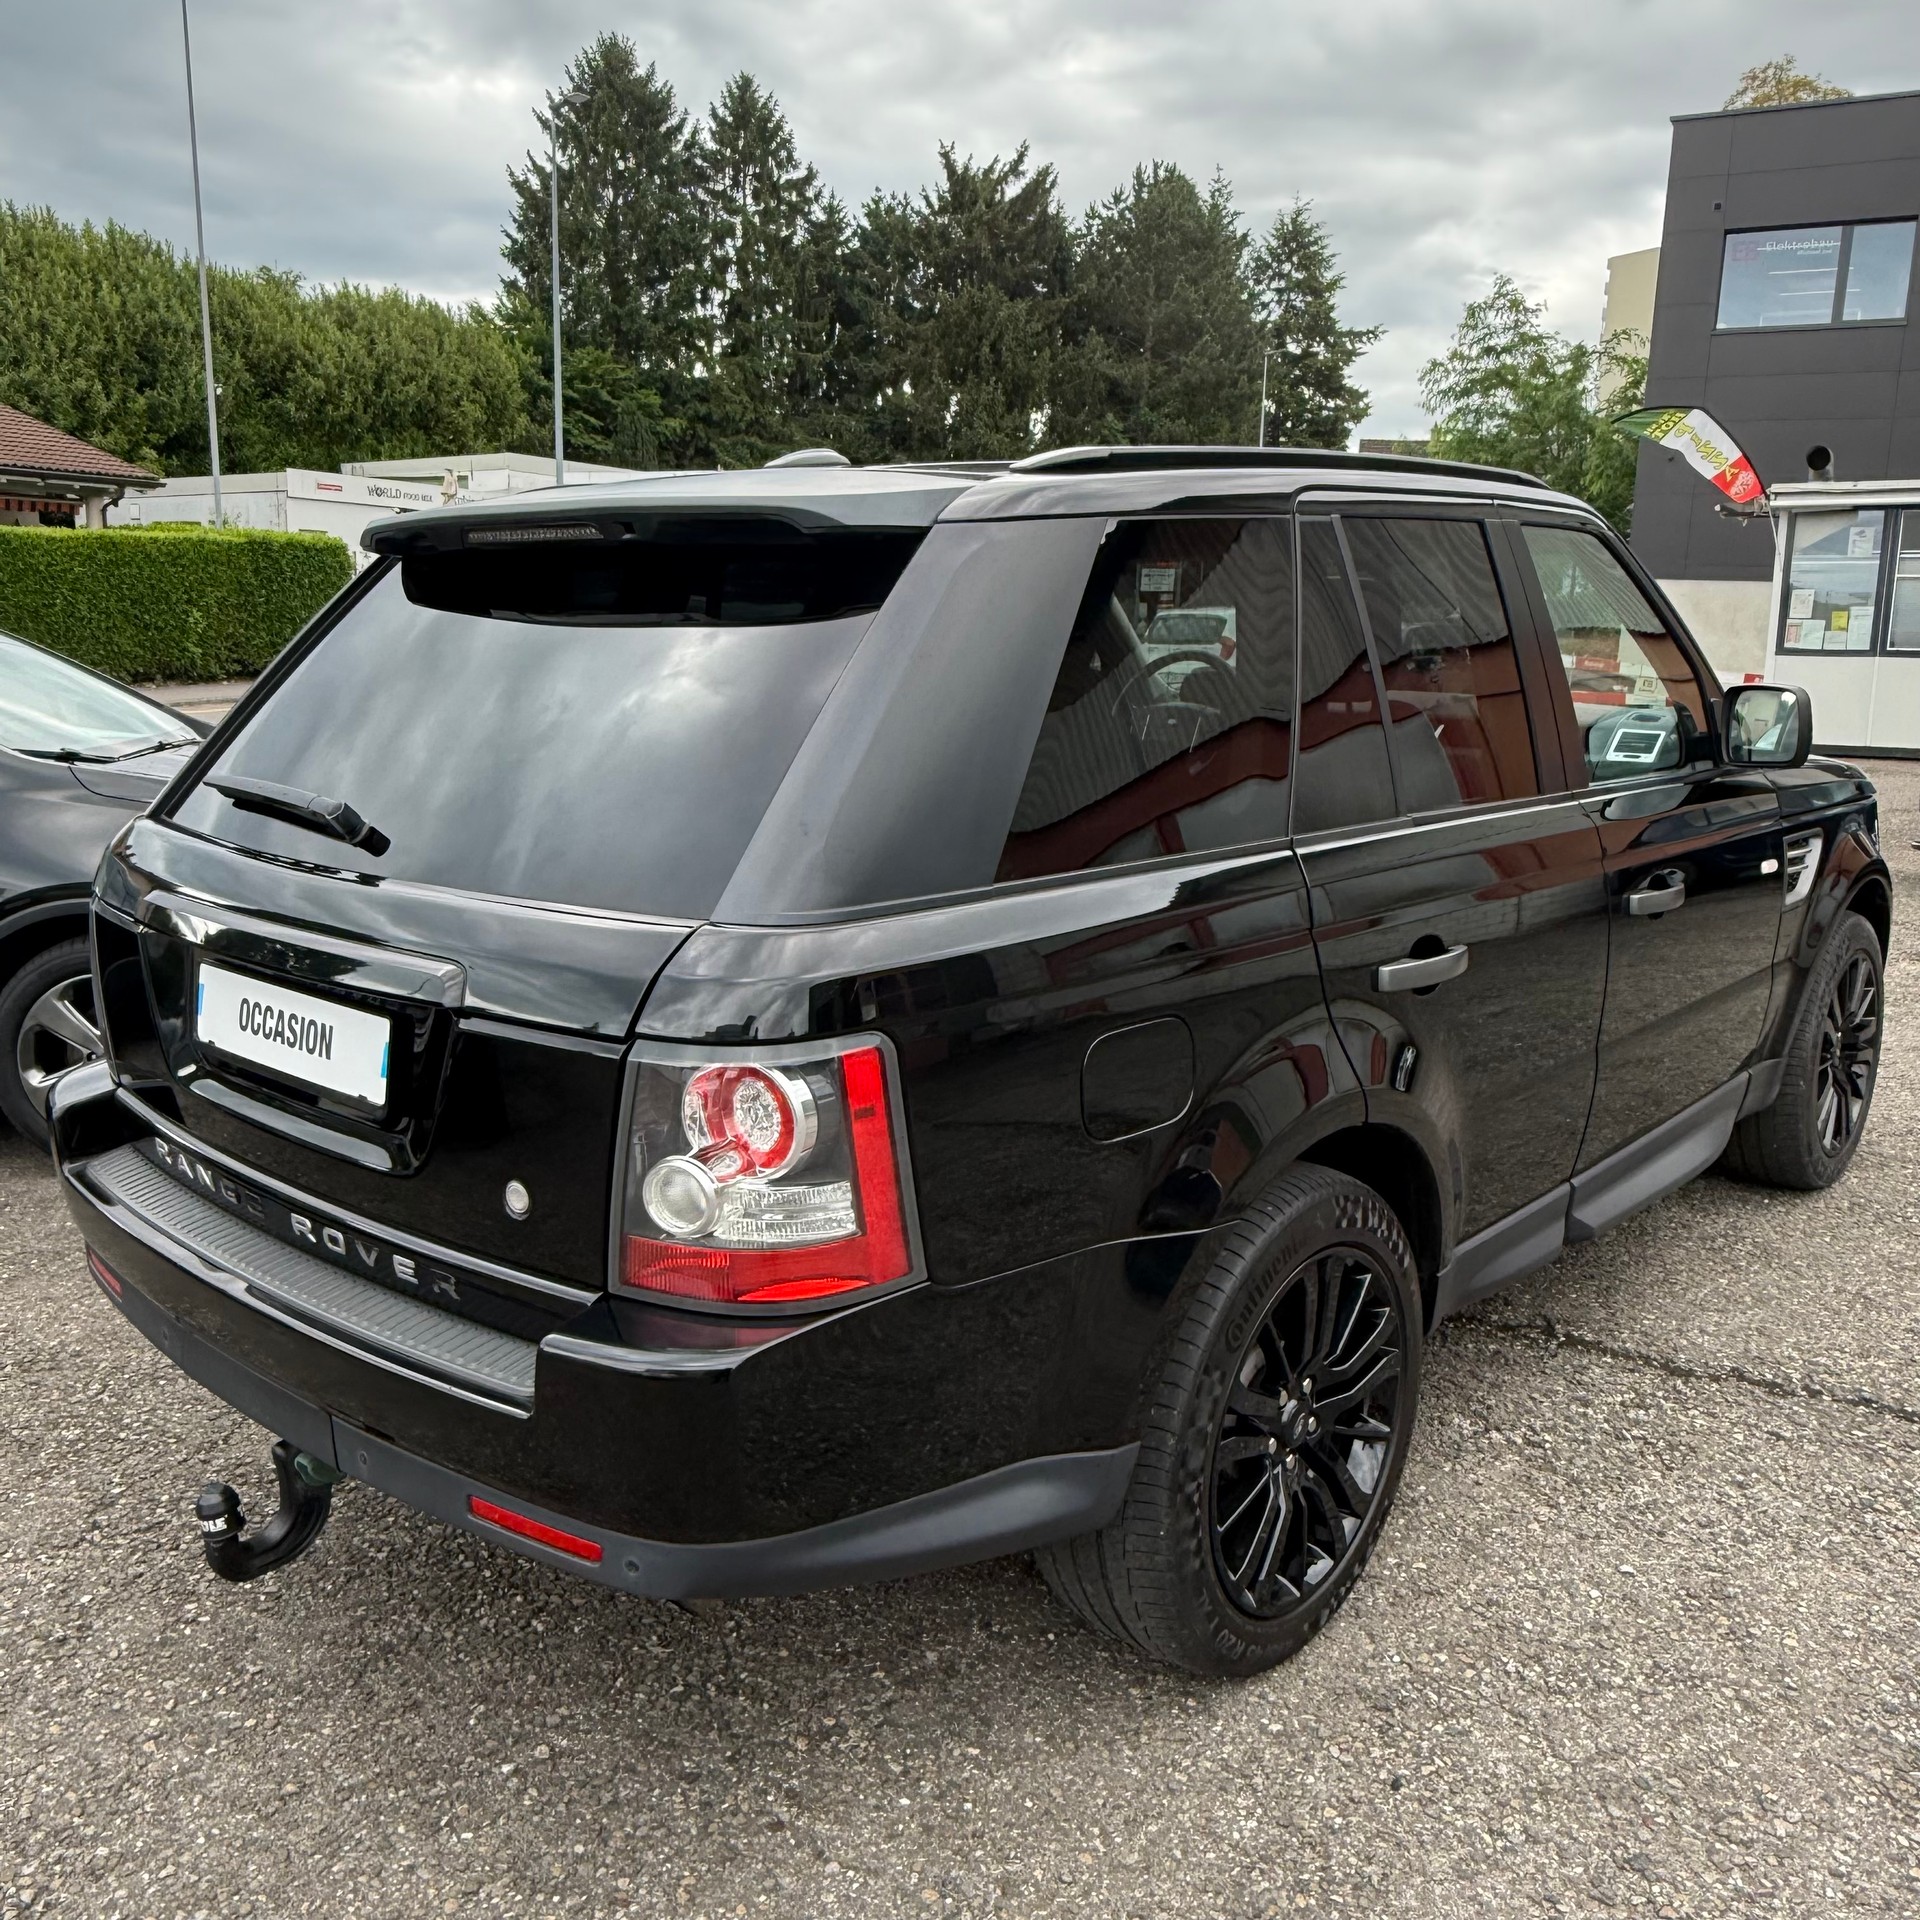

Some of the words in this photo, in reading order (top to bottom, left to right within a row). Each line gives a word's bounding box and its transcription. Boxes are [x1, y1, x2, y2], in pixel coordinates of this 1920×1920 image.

[367, 484, 402, 499] WORLD
[239, 998, 334, 1060] OCCASION
[155, 1136, 265, 1219] RANGE
[291, 1212, 460, 1301] ROVER
